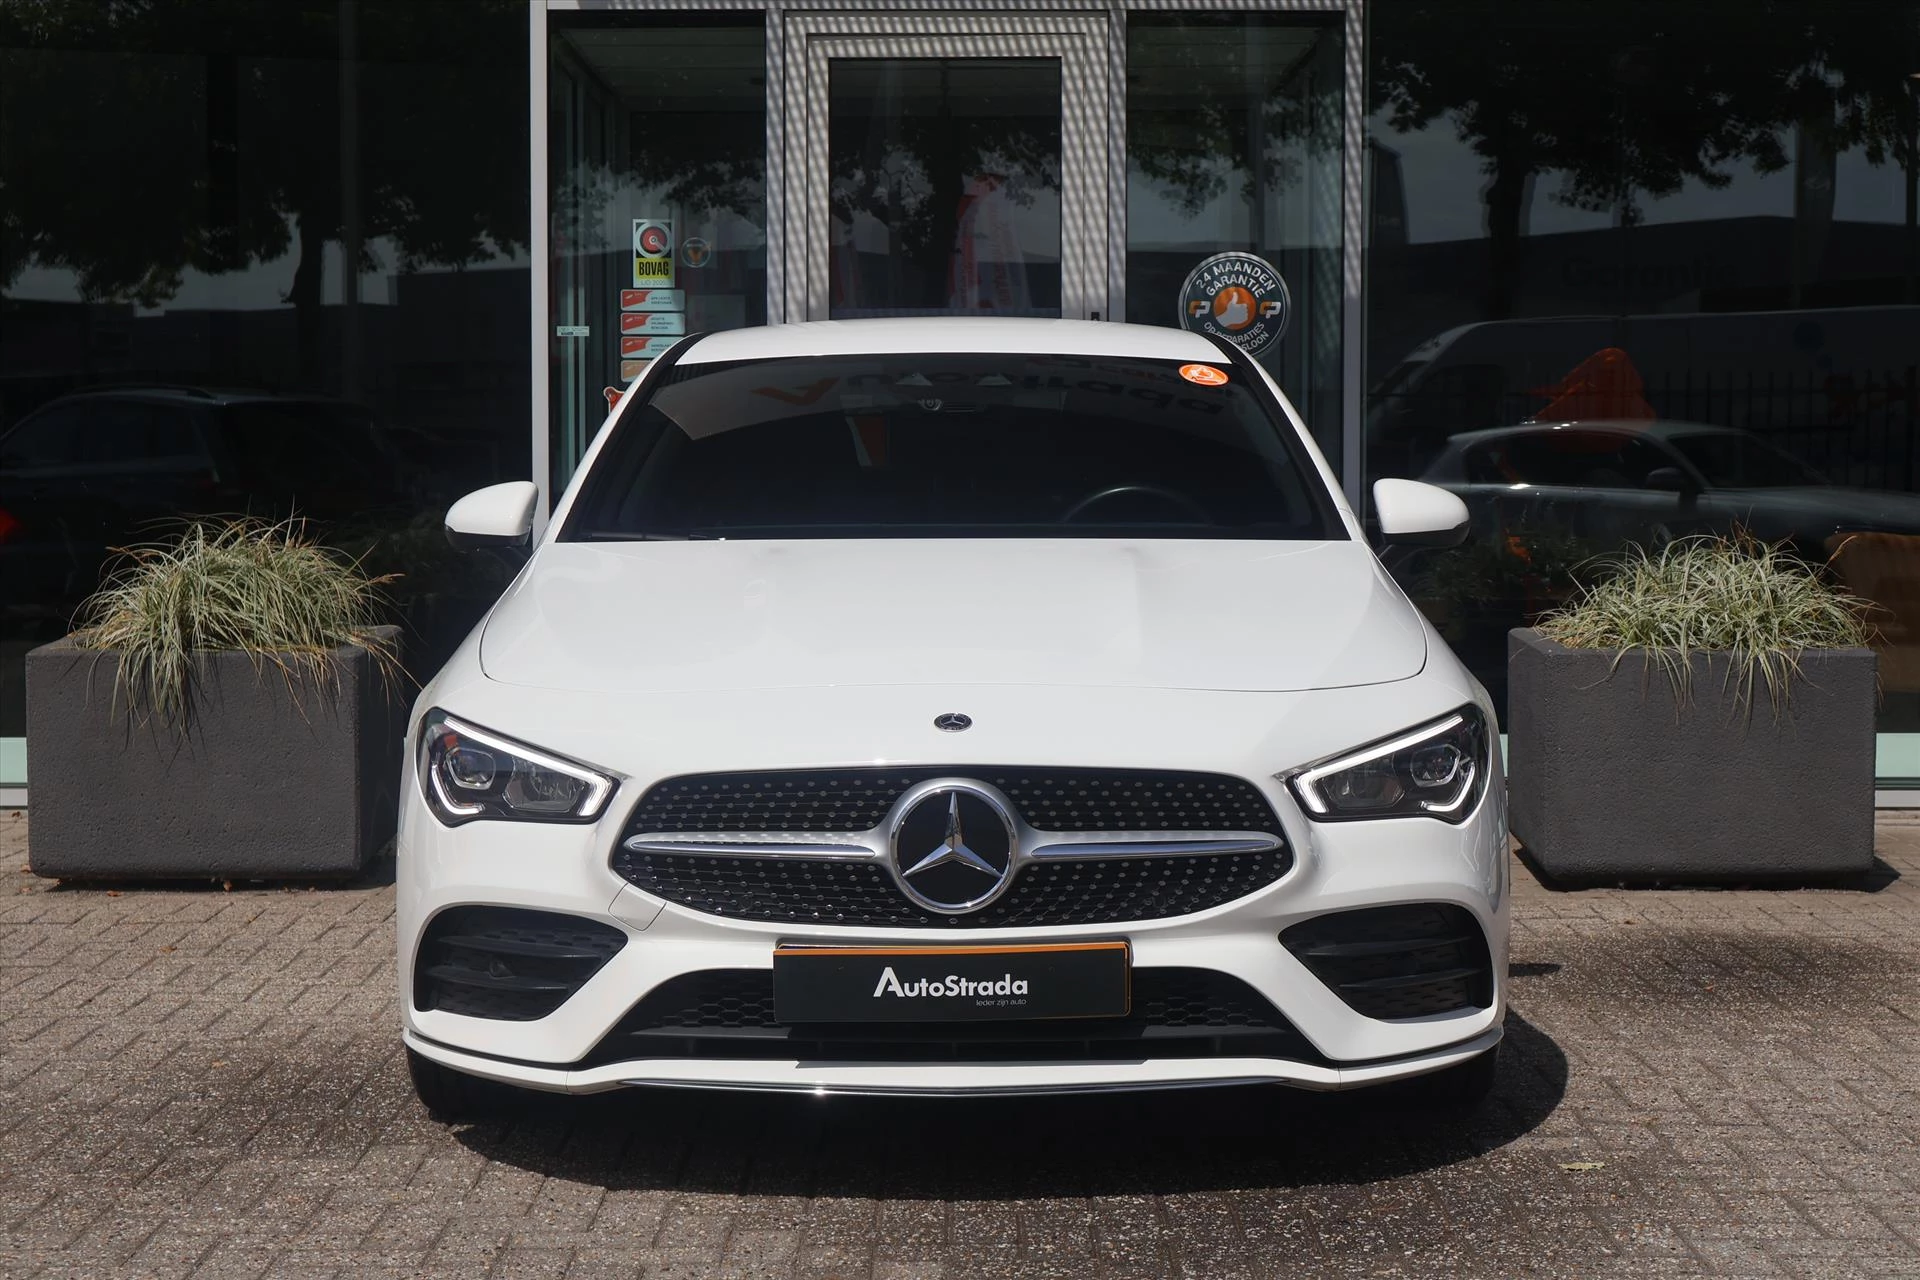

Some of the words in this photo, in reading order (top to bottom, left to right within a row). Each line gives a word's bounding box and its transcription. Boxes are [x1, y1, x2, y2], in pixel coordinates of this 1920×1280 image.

[639, 261, 669, 276] BOVAG
[1196, 273, 1212, 288] 24
[1213, 262, 1276, 291] MAANDEN
[1206, 274, 1265, 298] GARANTIE
[873, 966, 1028, 997] AutoStrada
